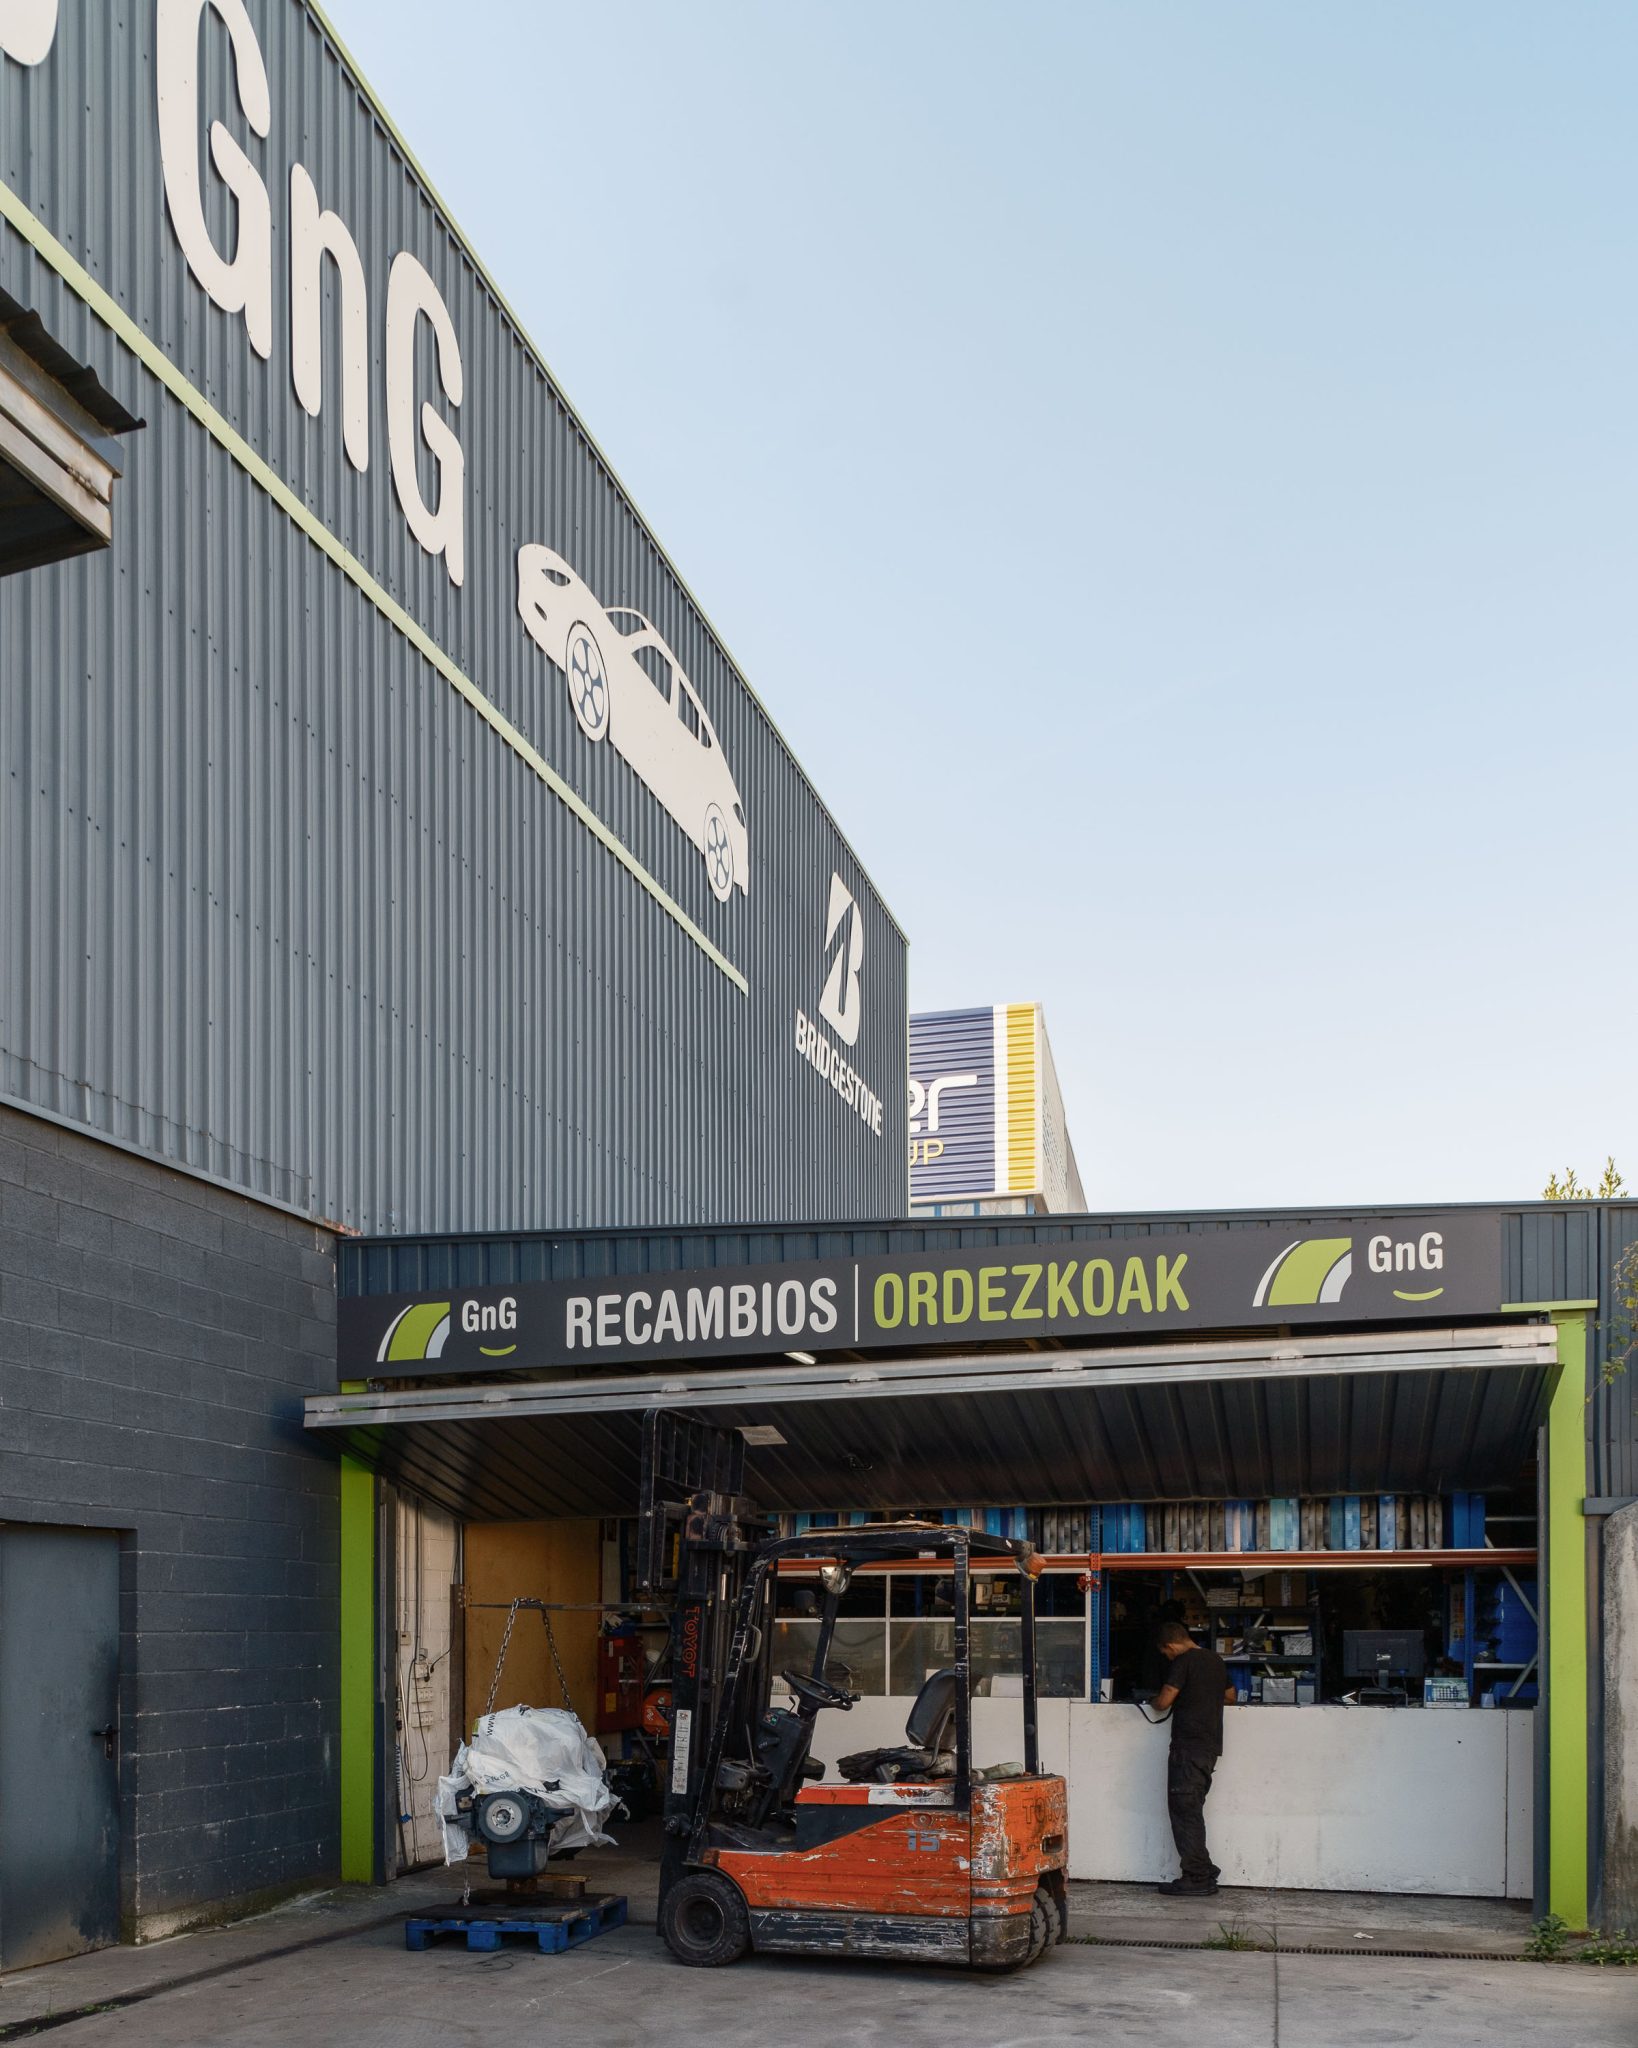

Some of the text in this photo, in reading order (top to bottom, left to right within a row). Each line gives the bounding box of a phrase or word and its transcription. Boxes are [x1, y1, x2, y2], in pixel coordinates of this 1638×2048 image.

[157, 0, 464, 586] GnG
[796, 1009, 882, 1137] BRIDGESTONE
[1368, 1232, 1443, 1273] GnG
[461, 1297, 517, 1332] GnG
[566, 1253, 1190, 1349] RECAMBIOS ORDEZKOAK
[905, 1828, 940, 1852] 15
